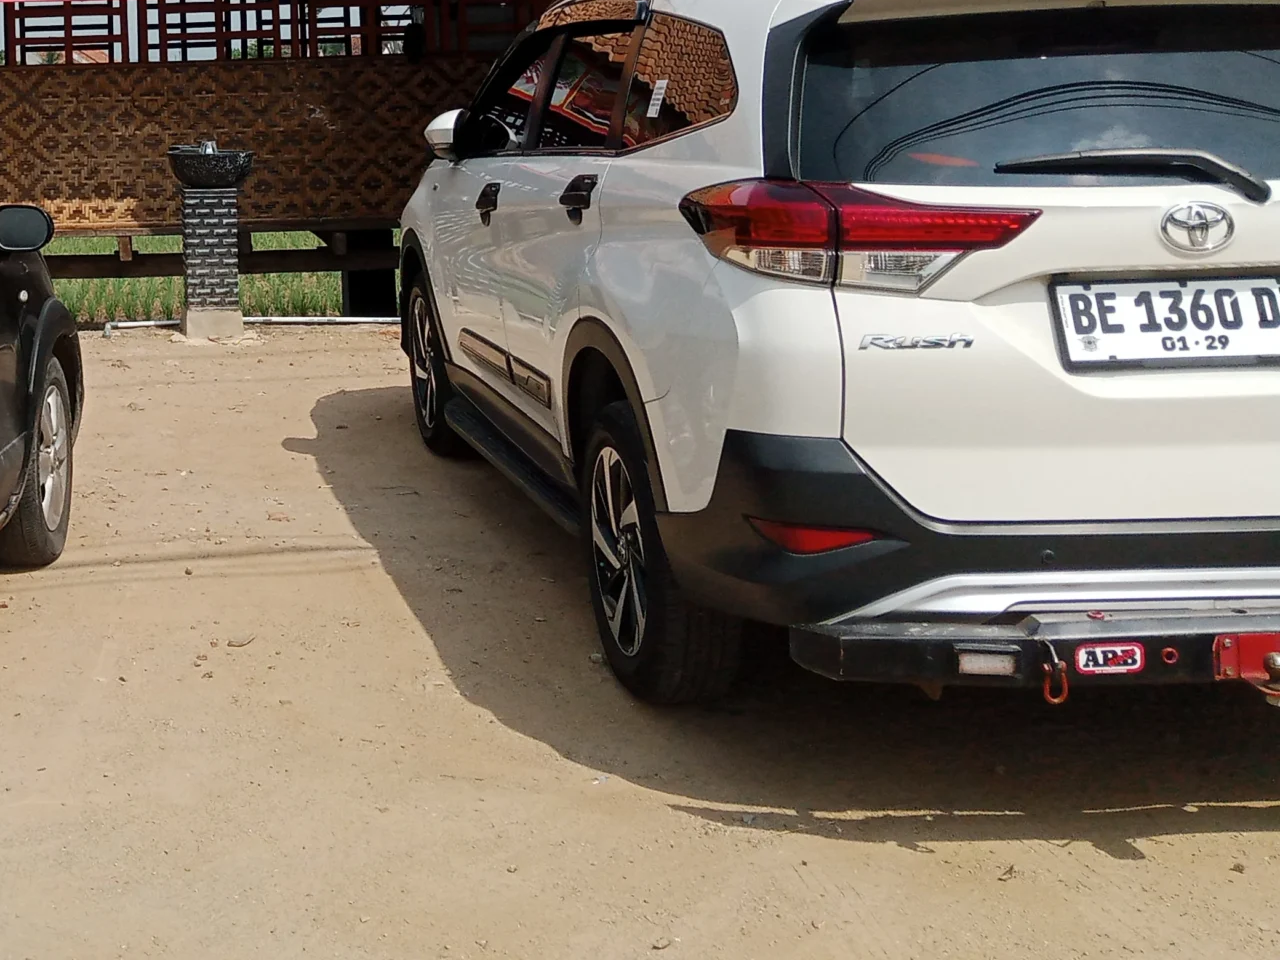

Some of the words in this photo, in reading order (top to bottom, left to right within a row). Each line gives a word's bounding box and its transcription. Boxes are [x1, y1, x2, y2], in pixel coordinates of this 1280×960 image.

[1069, 292, 1125, 335] BE
[1134, 289, 1243, 333] 1360
[858, 333, 974, 350] Rush
